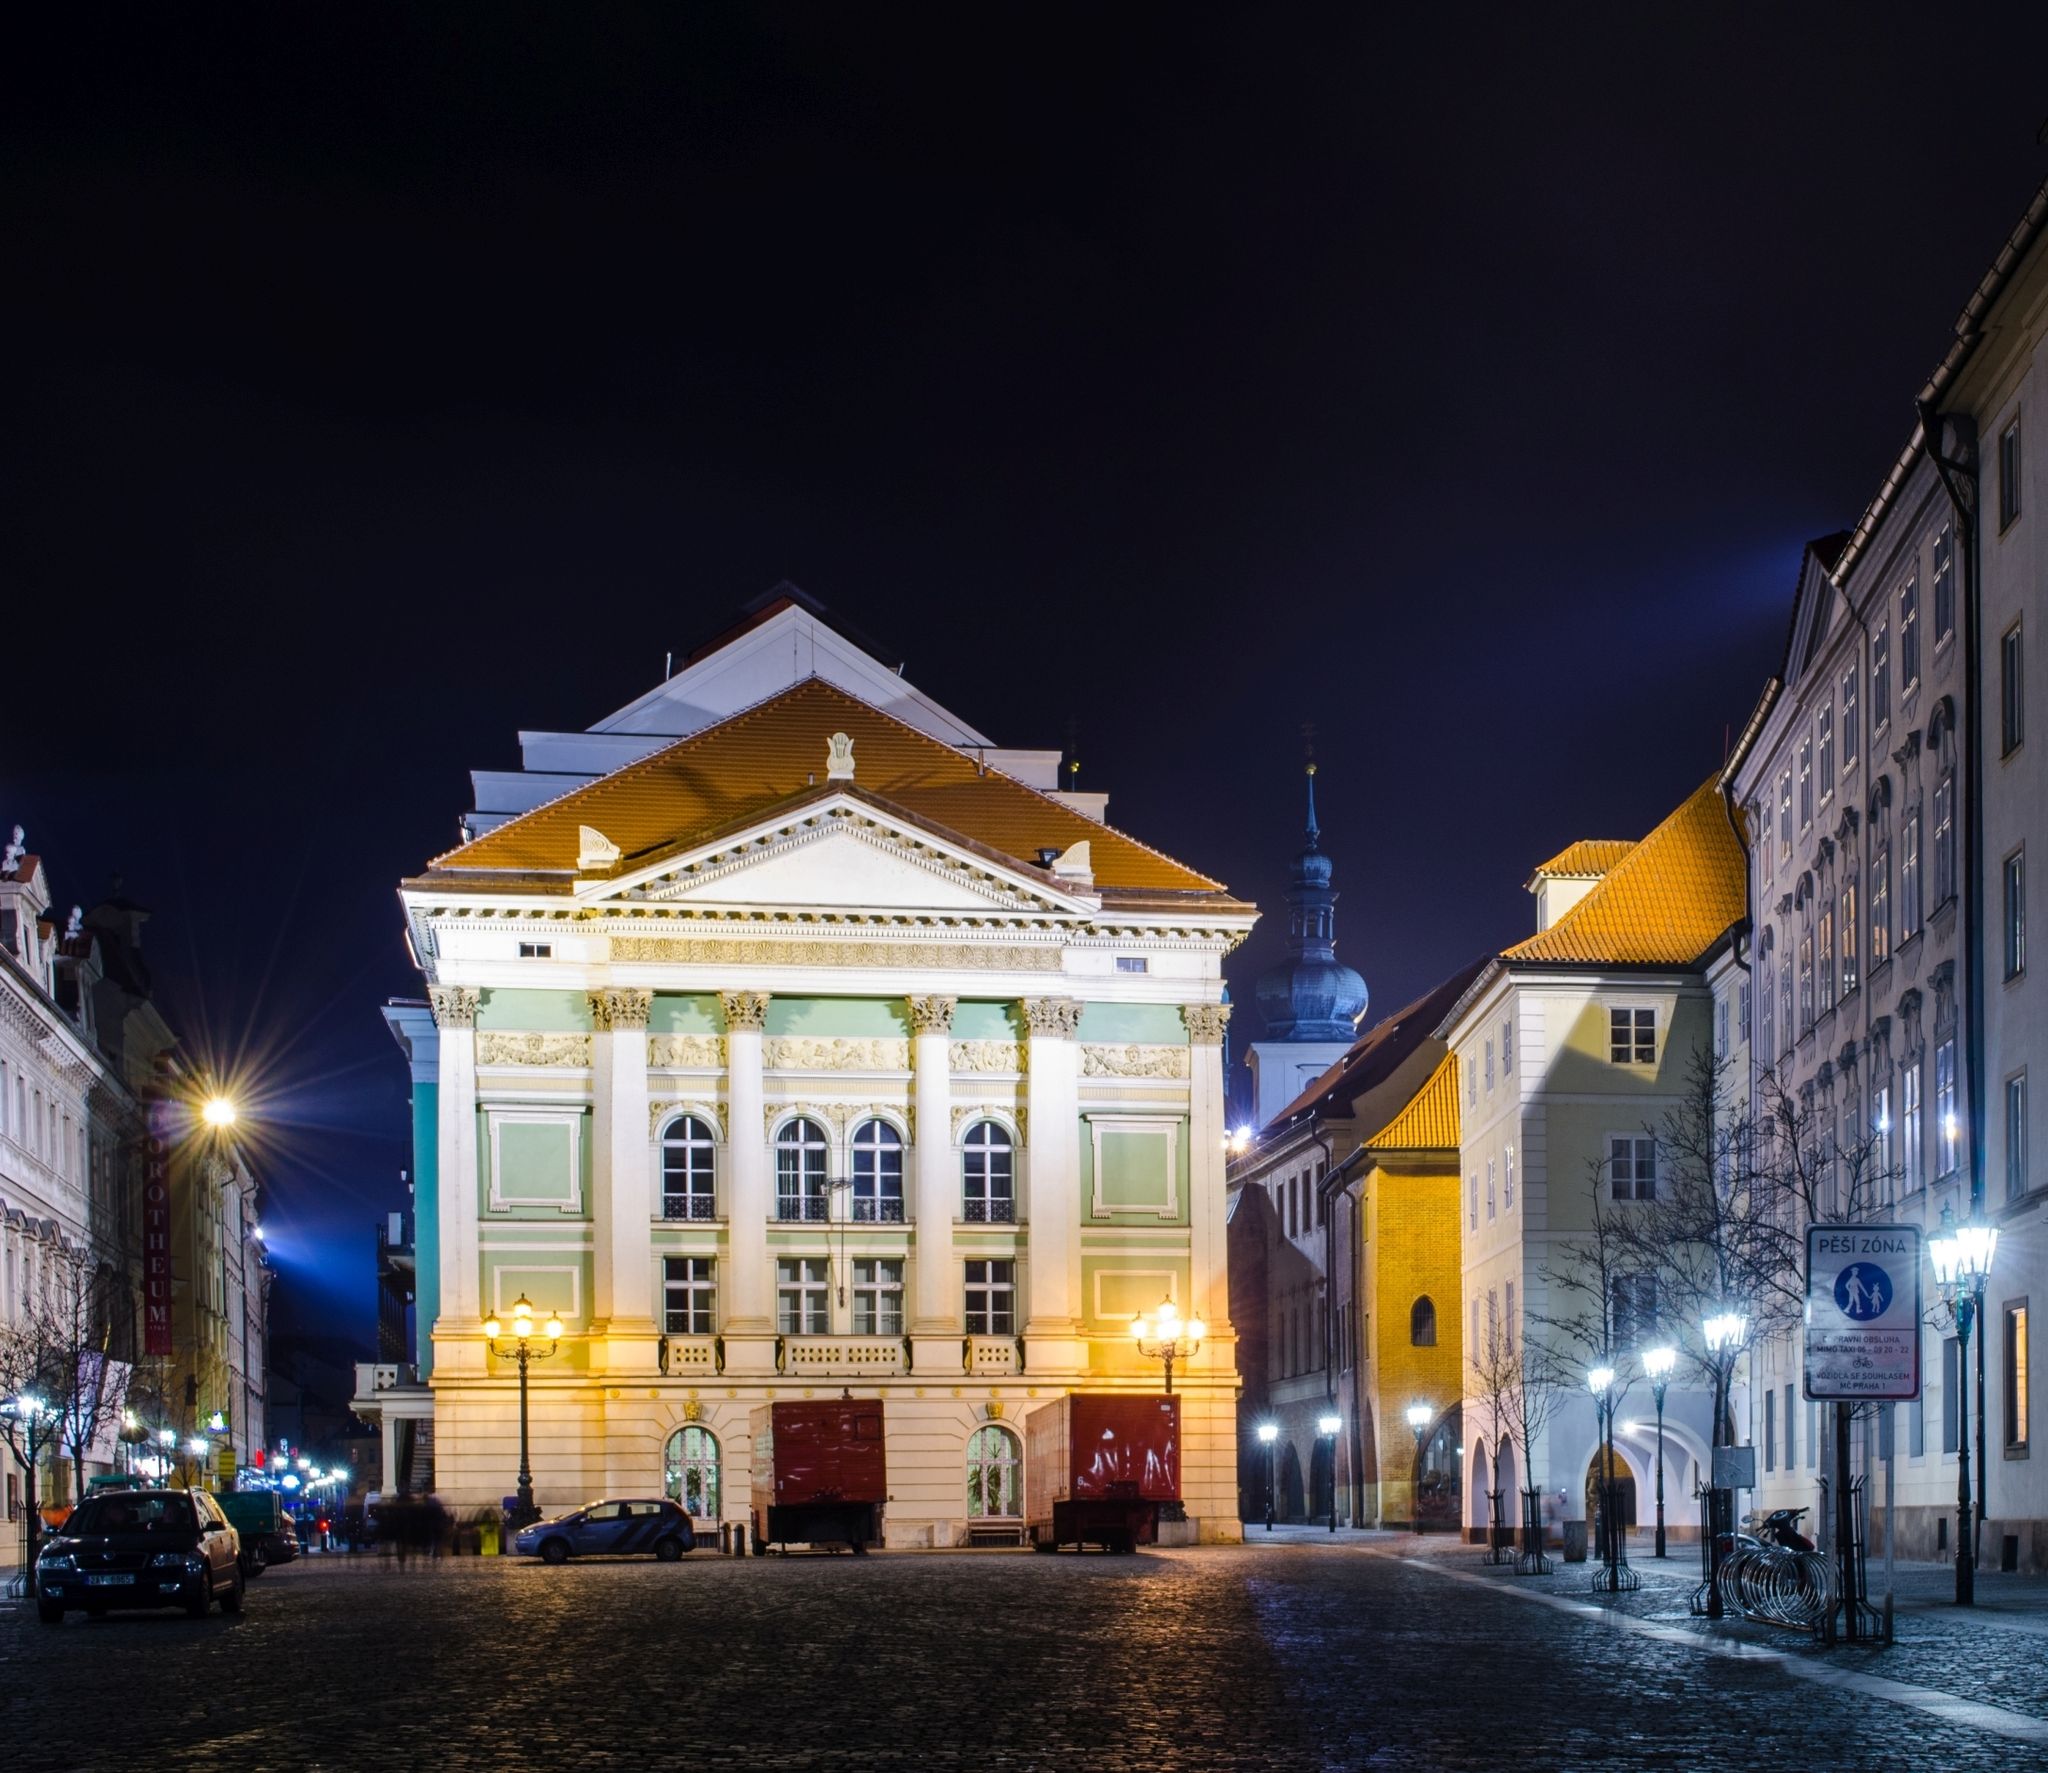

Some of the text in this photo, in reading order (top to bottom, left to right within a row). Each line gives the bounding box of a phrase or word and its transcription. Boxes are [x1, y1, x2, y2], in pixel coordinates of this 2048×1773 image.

[1819, 1235, 1906, 1253] PĚŠÍ ZÓNA
[1863, 1335, 1901, 1344] OBSLUHA
[1862, 1372, 1910, 1380] SOUHLASEM
[1840, 1380, 1851, 1390] MČ
[1853, 1382, 1880, 1390] PRAHA
[777, 1479, 784, 1490] 1
[1077, 1475, 1084, 1486] 6
